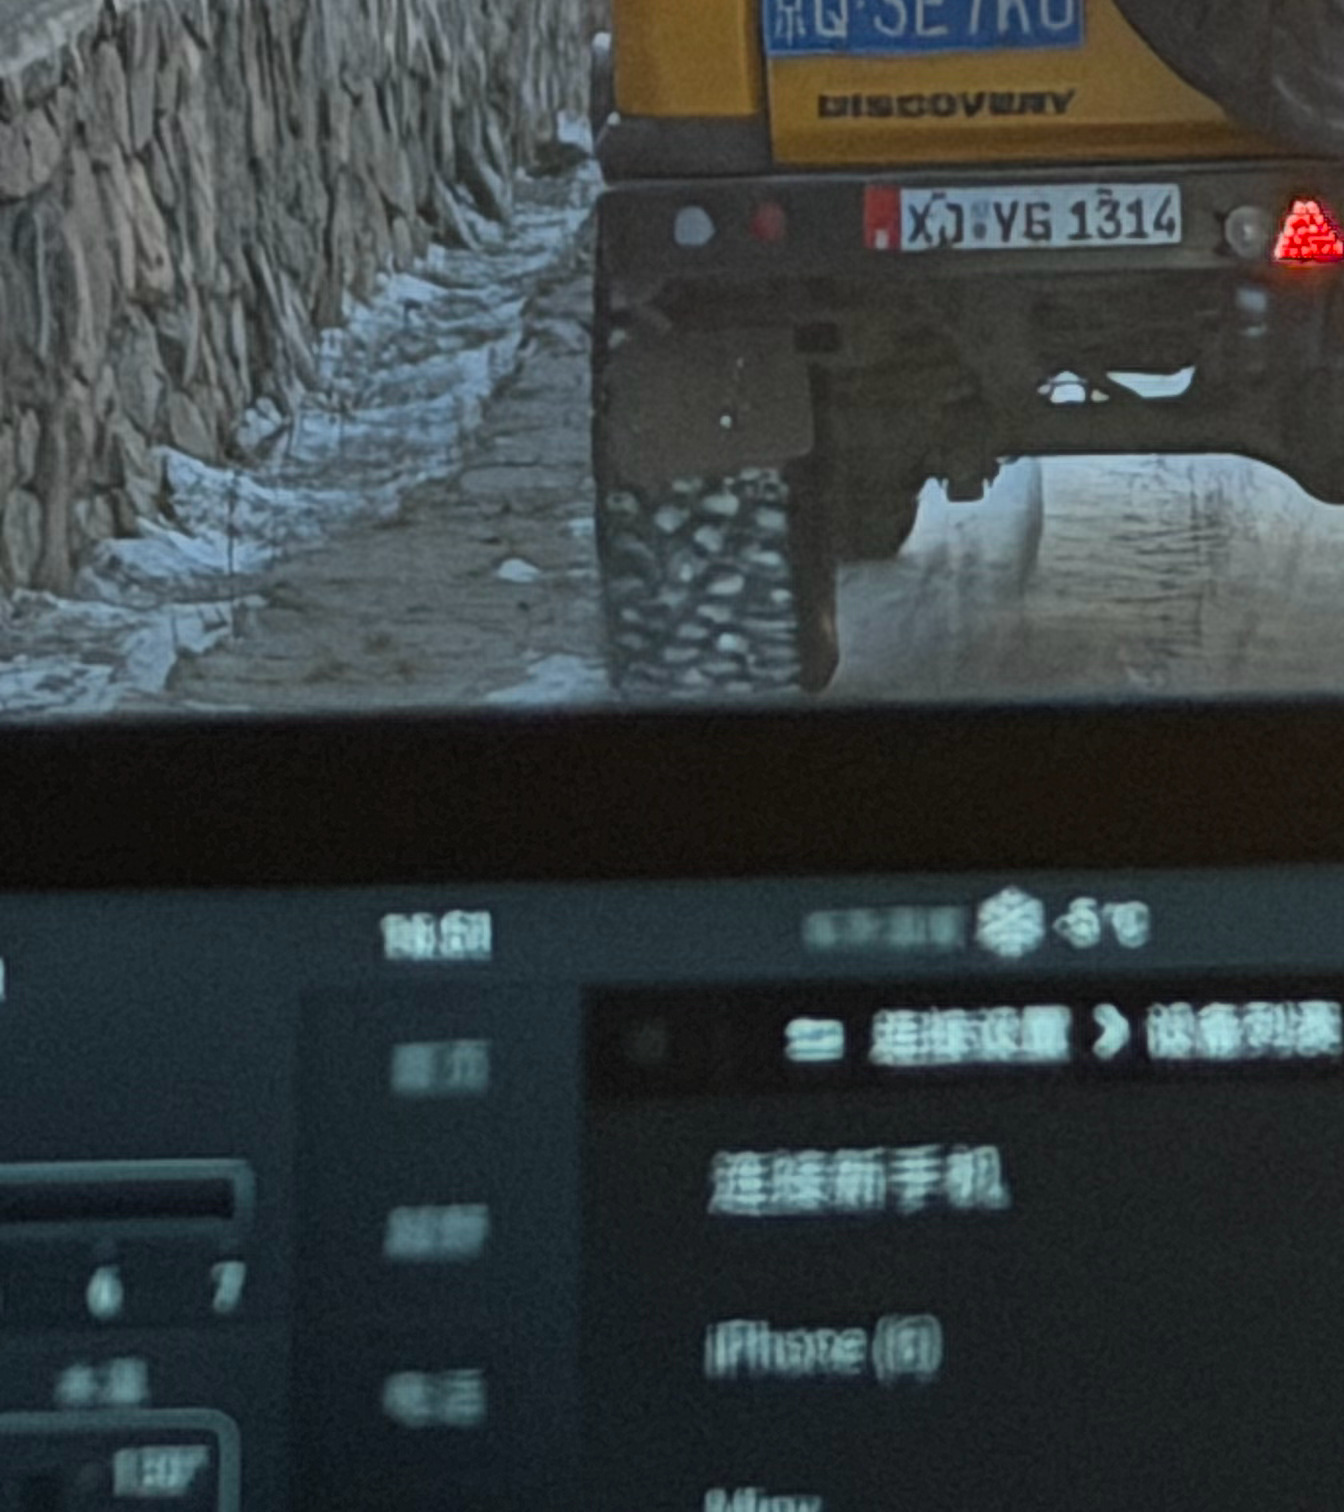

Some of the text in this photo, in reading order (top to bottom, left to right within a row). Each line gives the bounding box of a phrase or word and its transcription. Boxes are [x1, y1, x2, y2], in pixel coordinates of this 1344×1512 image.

[817, 88, 1076, 119] DISCOVERY
[1067, 194, 1178, 241] 1314
[704, 1319, 868, 1379] iPhone
